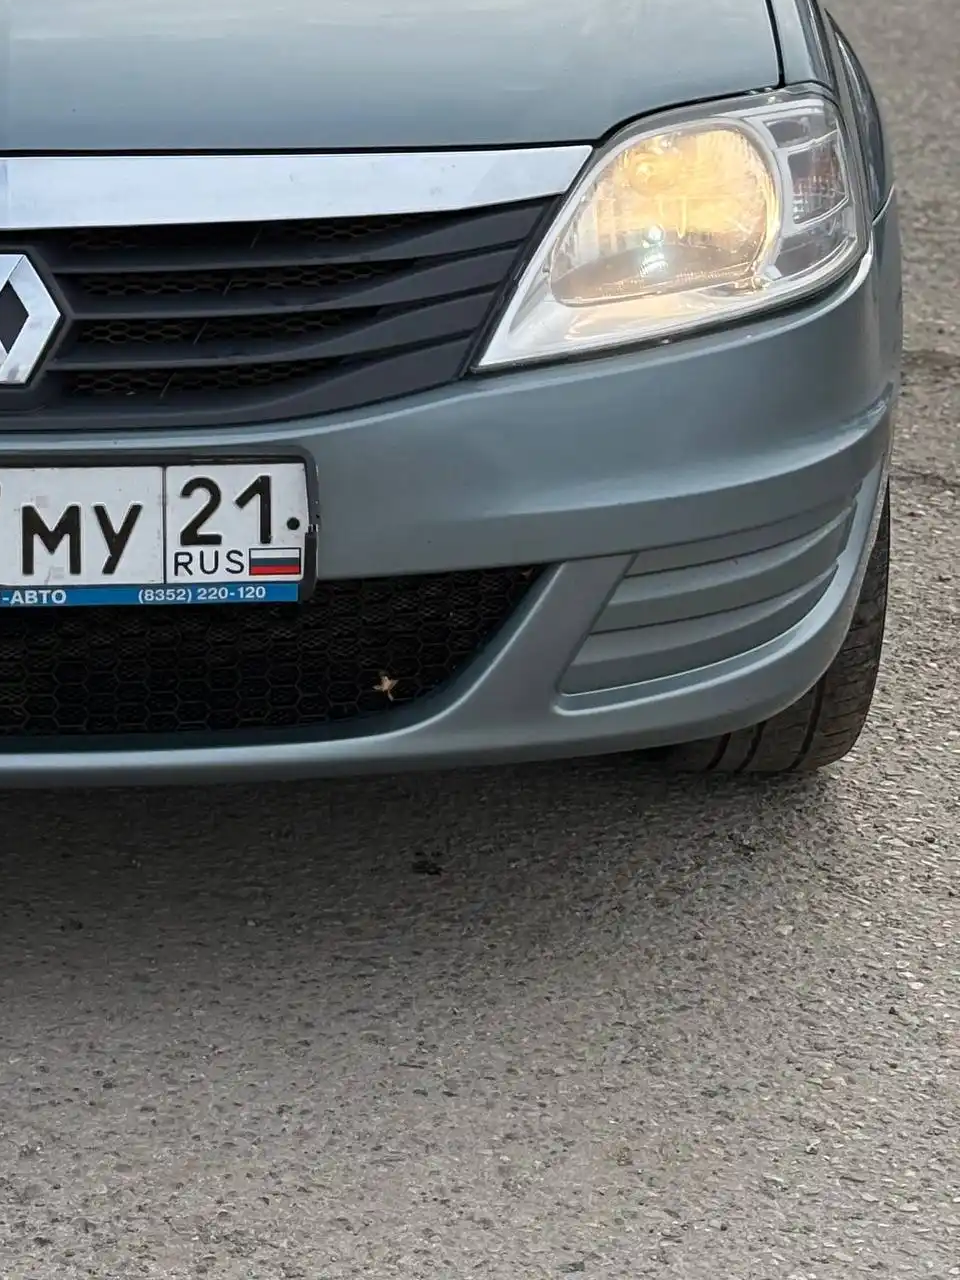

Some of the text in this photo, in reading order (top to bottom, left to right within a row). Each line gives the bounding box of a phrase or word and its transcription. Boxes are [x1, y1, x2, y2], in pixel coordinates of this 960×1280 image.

[179, 474, 272, 546] 21
[173, 549, 245, 577] RUS
[137, 585, 267, 604] (8352) 220-120
